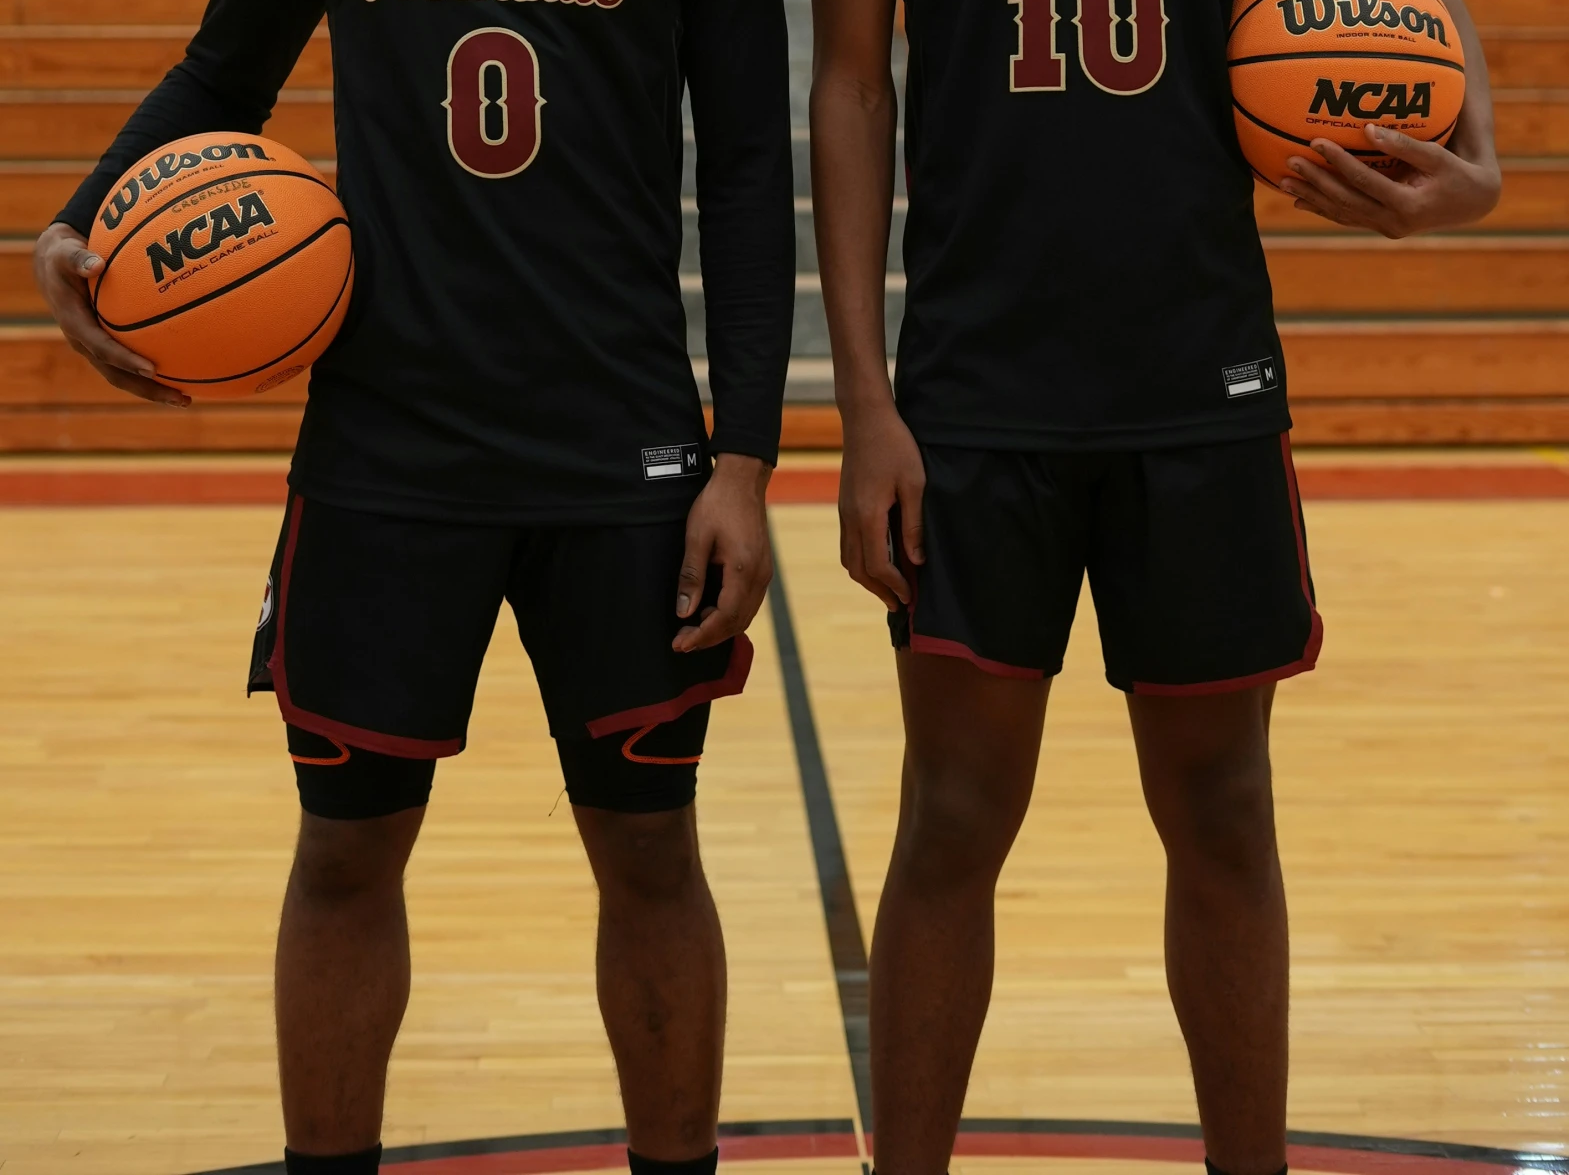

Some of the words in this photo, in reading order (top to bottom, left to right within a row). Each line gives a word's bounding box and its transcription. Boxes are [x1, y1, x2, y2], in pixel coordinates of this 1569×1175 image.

[1398, 35, 1417, 43] BALL
[440, 26, 547, 179] 0
[1308, 78, 1431, 120] NCAA
[1305, 117, 1361, 129] OFFICIAL
[1400, 122, 1427, 130] BALL
[100, 143, 270, 231] Wilson
[144, 182, 174, 204] INDOOR
[176, 170, 200, 183] GAME
[202, 164, 225, 172] BALL
[171, 179, 252, 214] CREEKSIDE
[145, 191, 276, 284] NCAA
[158, 264, 209, 294] OFFICIAL
[209, 242, 246, 264] GAME
[247, 230, 279, 246] BALL
[1265, 367, 1273, 381] M
[687, 453, 697, 467] M
